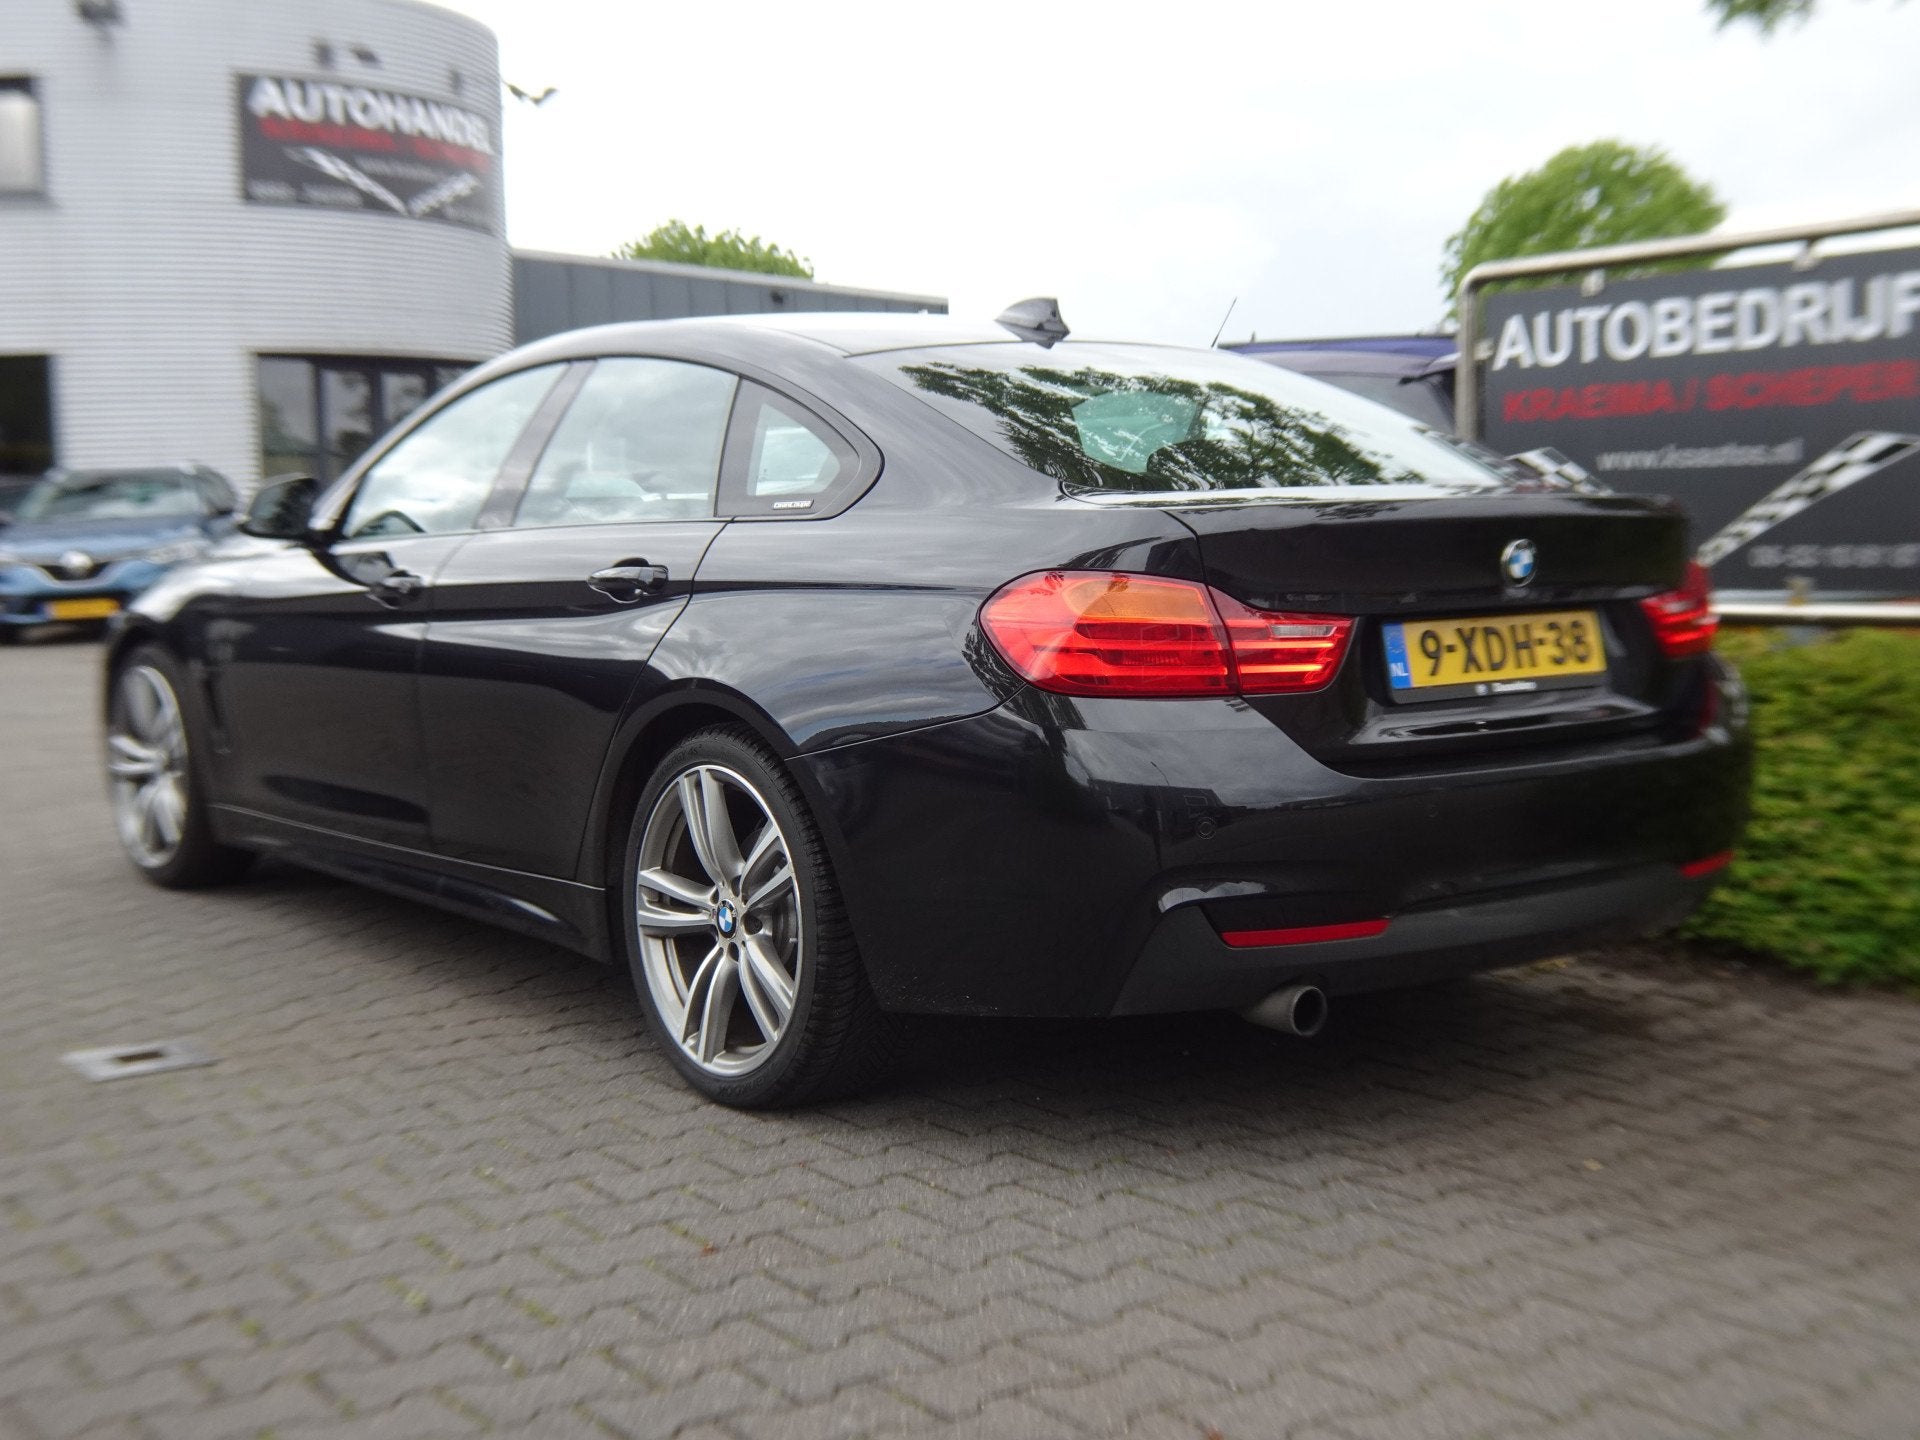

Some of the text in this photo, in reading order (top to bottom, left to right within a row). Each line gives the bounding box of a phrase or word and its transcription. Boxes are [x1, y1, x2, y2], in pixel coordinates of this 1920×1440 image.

[1492, 270, 1920, 371] AUTOBEDRIJF
[1390, 662, 1409, 677] NL
[1420, 619, 1592, 677] 9-XDH-38
